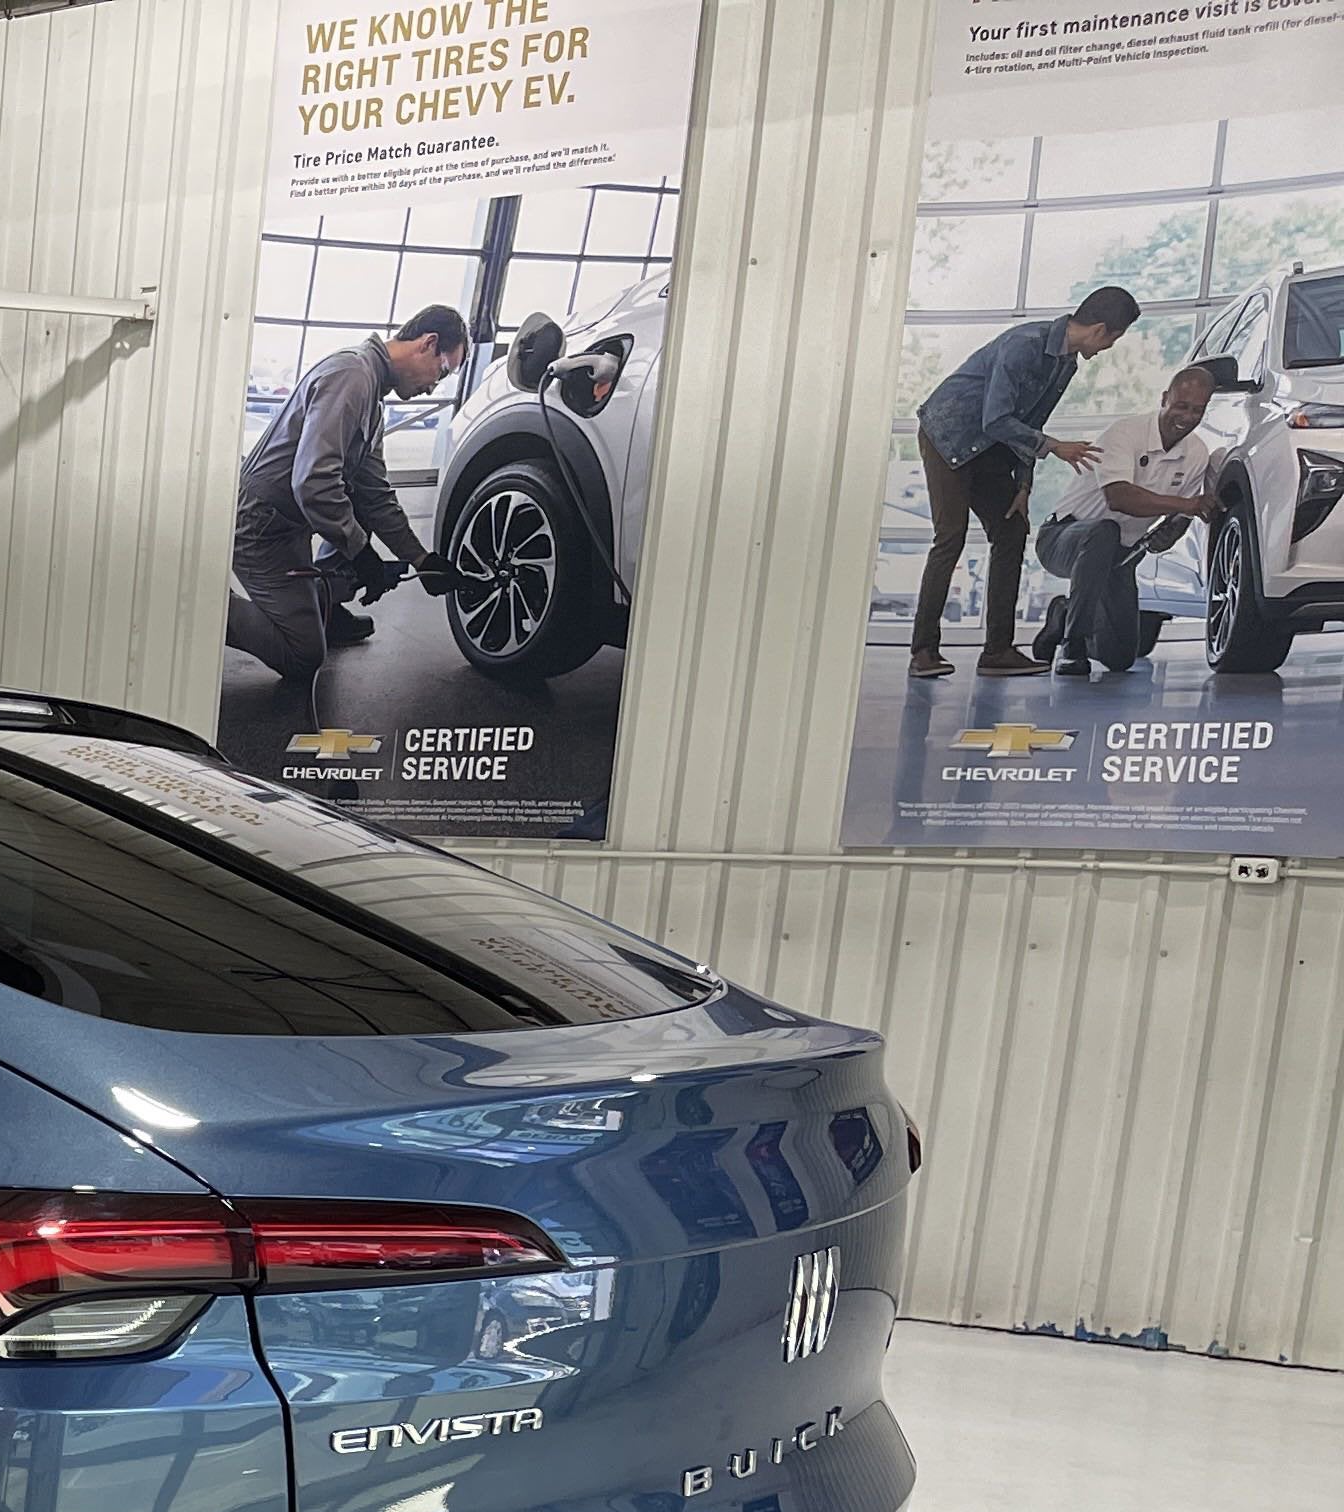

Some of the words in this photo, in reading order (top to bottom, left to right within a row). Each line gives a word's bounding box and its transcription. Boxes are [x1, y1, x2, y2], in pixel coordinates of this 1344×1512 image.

[306, 18, 358, 54] WE
[367, 1, 473, 47] KNOW
[484, 0, 548, 30] THE
[965, 51, 1009, 62] Includes:
[1010, 49, 1023, 59] oil
[1024, 49, 1043, 58] and
[1044, 46, 1057, 56] oil
[1058, 44, 1083, 55] filter
[1085, 41, 1125, 54] change,
[1126, 36, 1157, 48] diesel
[1158, 31, 1199, 45] exhaust
[1201, 28, 1225, 40] fluid
[1227, 25, 1251, 37] tank
[1253, 22, 1279, 33] refill
[1281, 19, 1301, 31] (for
[969, 26, 1011, 43] Your
[1016, 20, 1058, 39] first
[1063, 8, 1190, 35] maintenance
[1194, 1, 1239, 20] visit
[1244, 0, 1261, 13] is
[301, 53, 401, 96] RIGHT
[411, 38, 509, 82] TIRES
[521, 27, 590, 67] FOR
[964, 65, 992, 75] 4-tire
[993, 62, 1035, 73] rotation,
[1037, 60, 1055, 69] and
[1057, 55, 1112, 68] Multi-Point
[1114, 51, 1151, 63] Vehicle
[298, 97, 384, 136] YOUR
[395, 79, 514, 126] CHEVY
[523, 71, 575, 109] EV.
[291, 176, 319, 187] Provide
[332, 173, 349, 183] with
[357, 170, 381, 180] better
[413, 165, 433, 176] price
[435, 163, 443, 172] at
[445, 160, 459, 171] the
[461, 158, 479, 169] time
[481, 158, 490, 167] of
[491, 154, 531, 167] purchase,
[533, 150, 549, 161] and
[572, 144, 598, 155] match
[293, 153, 321, 169] Tire
[325, 149, 362, 166] Price
[367, 142, 412, 162] Match
[416, 134, 500, 156] Guarantee.
[289, 189, 306, 198] Find
[339, 184, 359, 196] price
[361, 182, 386, 192] within
[387, 180, 397, 189] 30
[399, 178, 417, 189] days
[418, 176, 427, 185] of
[429, 174, 442, 184] the
[443, 172, 483, 185] purchase,
[485, 169, 500, 178] and
[522, 162, 551, 173] refund
[553, 160, 567, 169] the
[404, 727, 535, 753] CERTIFIED
[1106, 721, 1275, 750] CERTIFIED
[282, 766, 384, 781] CHEVROLET
[401, 756, 509, 781] SERVICE
[941, 766, 1077, 783] CHEVROLET
[1100, 755, 1242, 784] SERVICE
[330, 1407, 544, 1454] ENVISTA
[682, 1406, 845, 1497] BUICK
